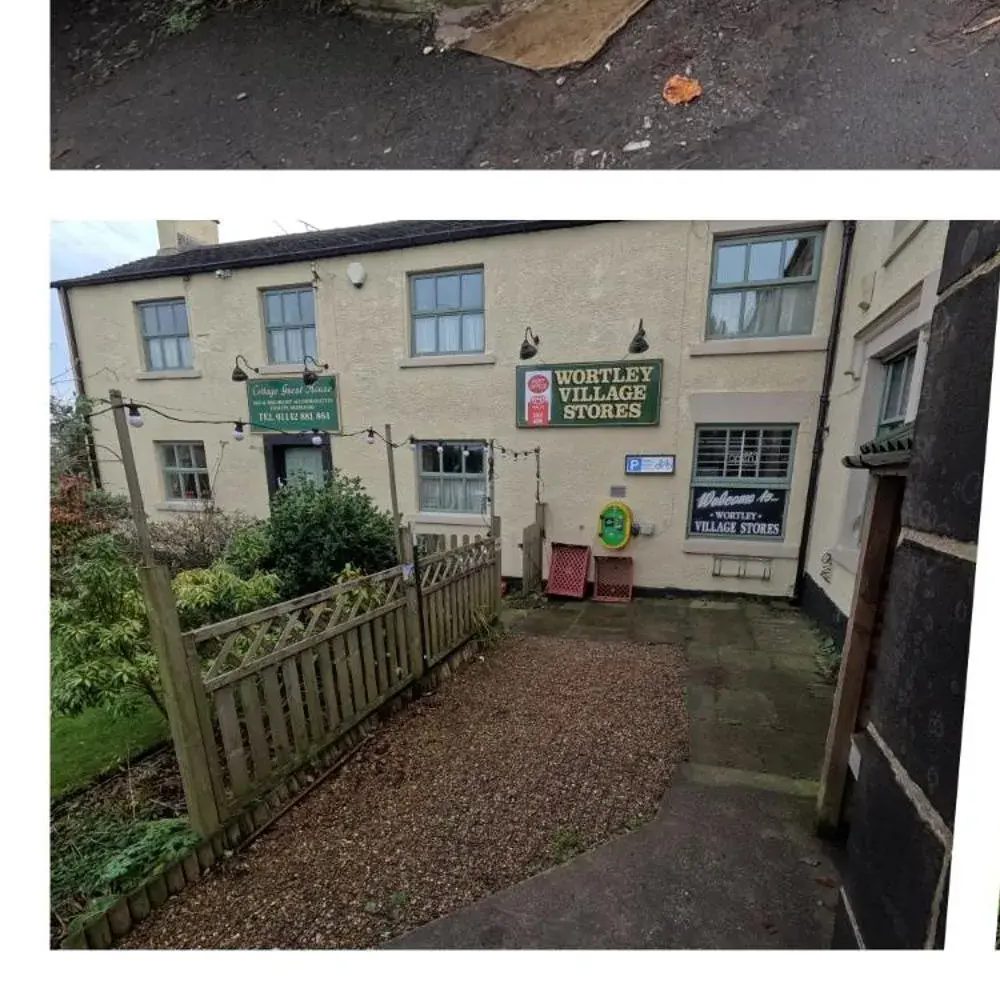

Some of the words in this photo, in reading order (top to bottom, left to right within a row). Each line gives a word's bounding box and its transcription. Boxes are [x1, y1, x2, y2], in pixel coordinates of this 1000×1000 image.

[555, 366, 654, 385] WORTLEY
[559, 385, 647, 403] VILLAGE
[563, 403, 642, 419] STORES
[697, 490, 756, 509] Welcome
[694, 520, 737, 533] VILLAGE
[740, 522, 780, 535] STORES
